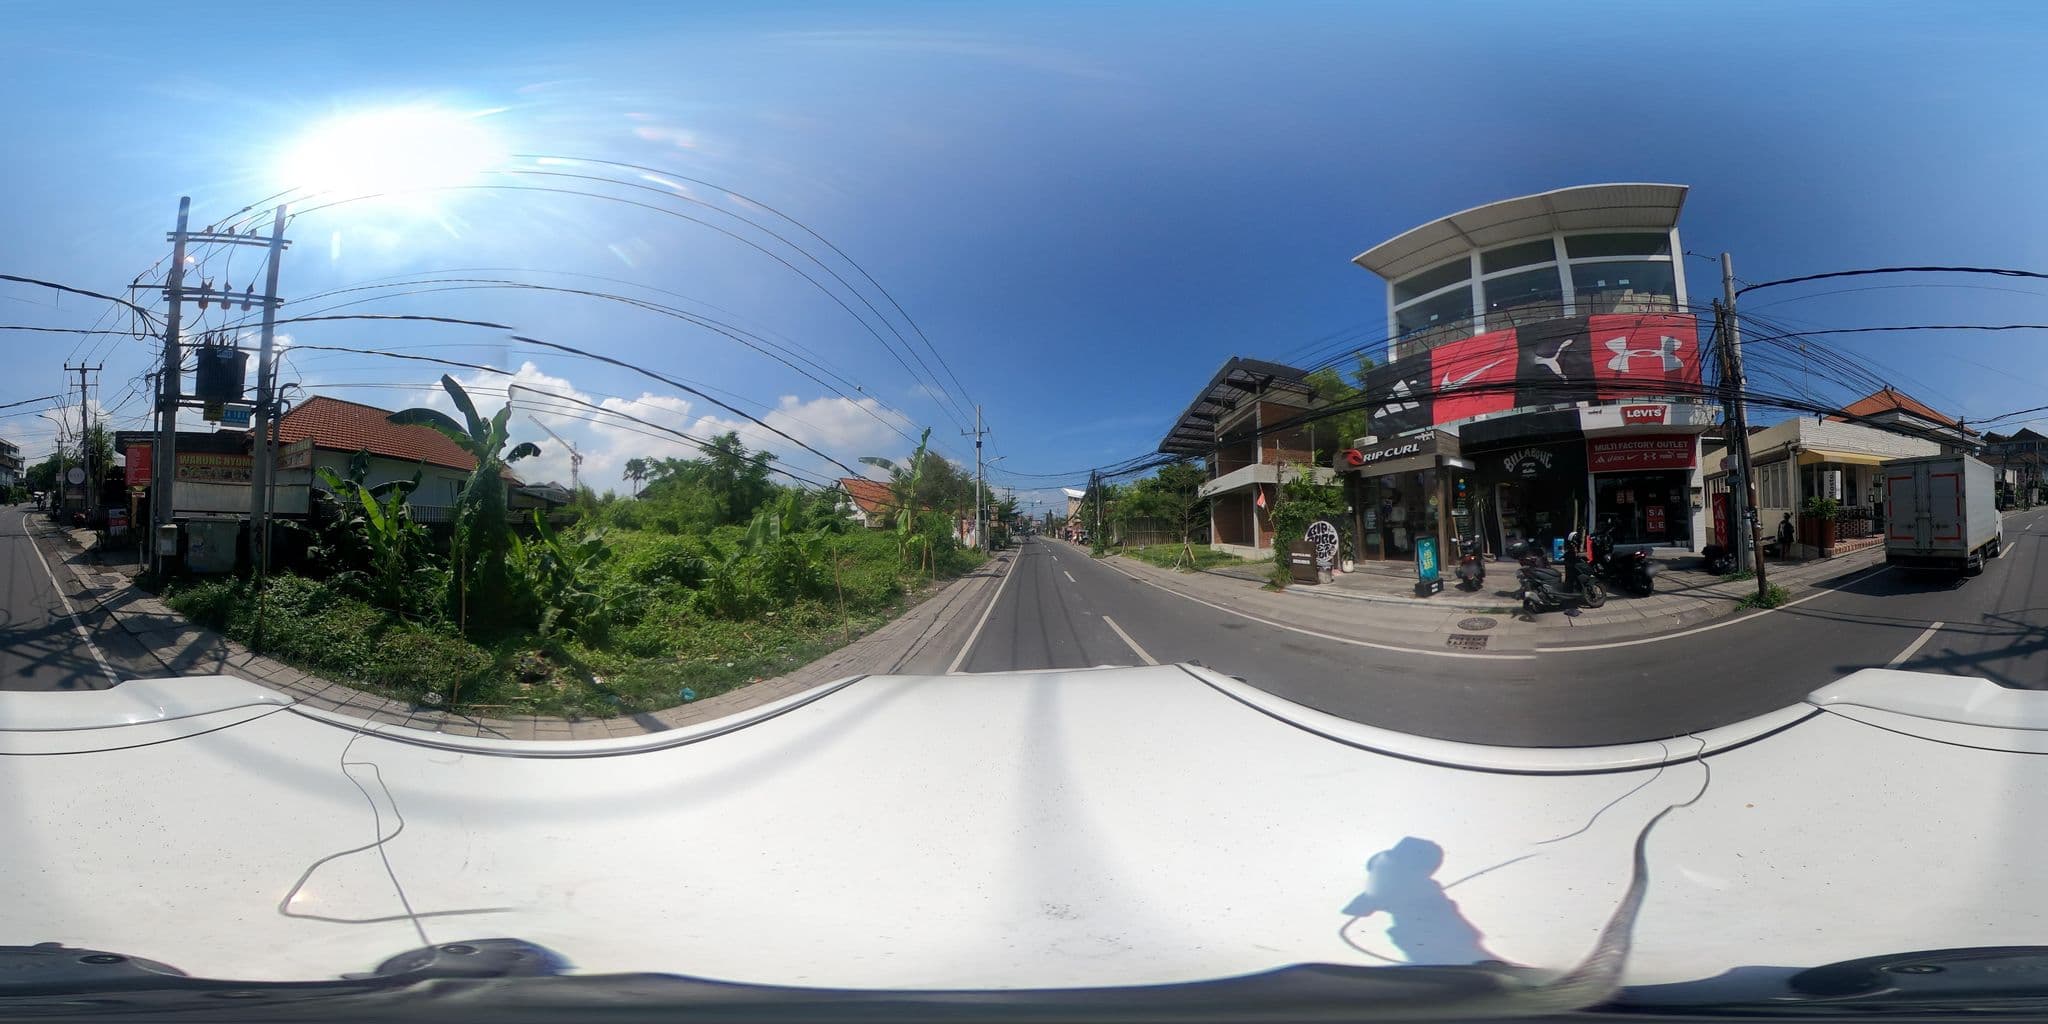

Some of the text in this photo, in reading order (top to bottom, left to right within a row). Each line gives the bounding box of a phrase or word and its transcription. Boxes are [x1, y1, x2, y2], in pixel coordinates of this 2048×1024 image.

[1363, 443, 1420, 462] RIP CURL
[1594, 440, 1688, 451] MULTI FACTORY OUTLET
